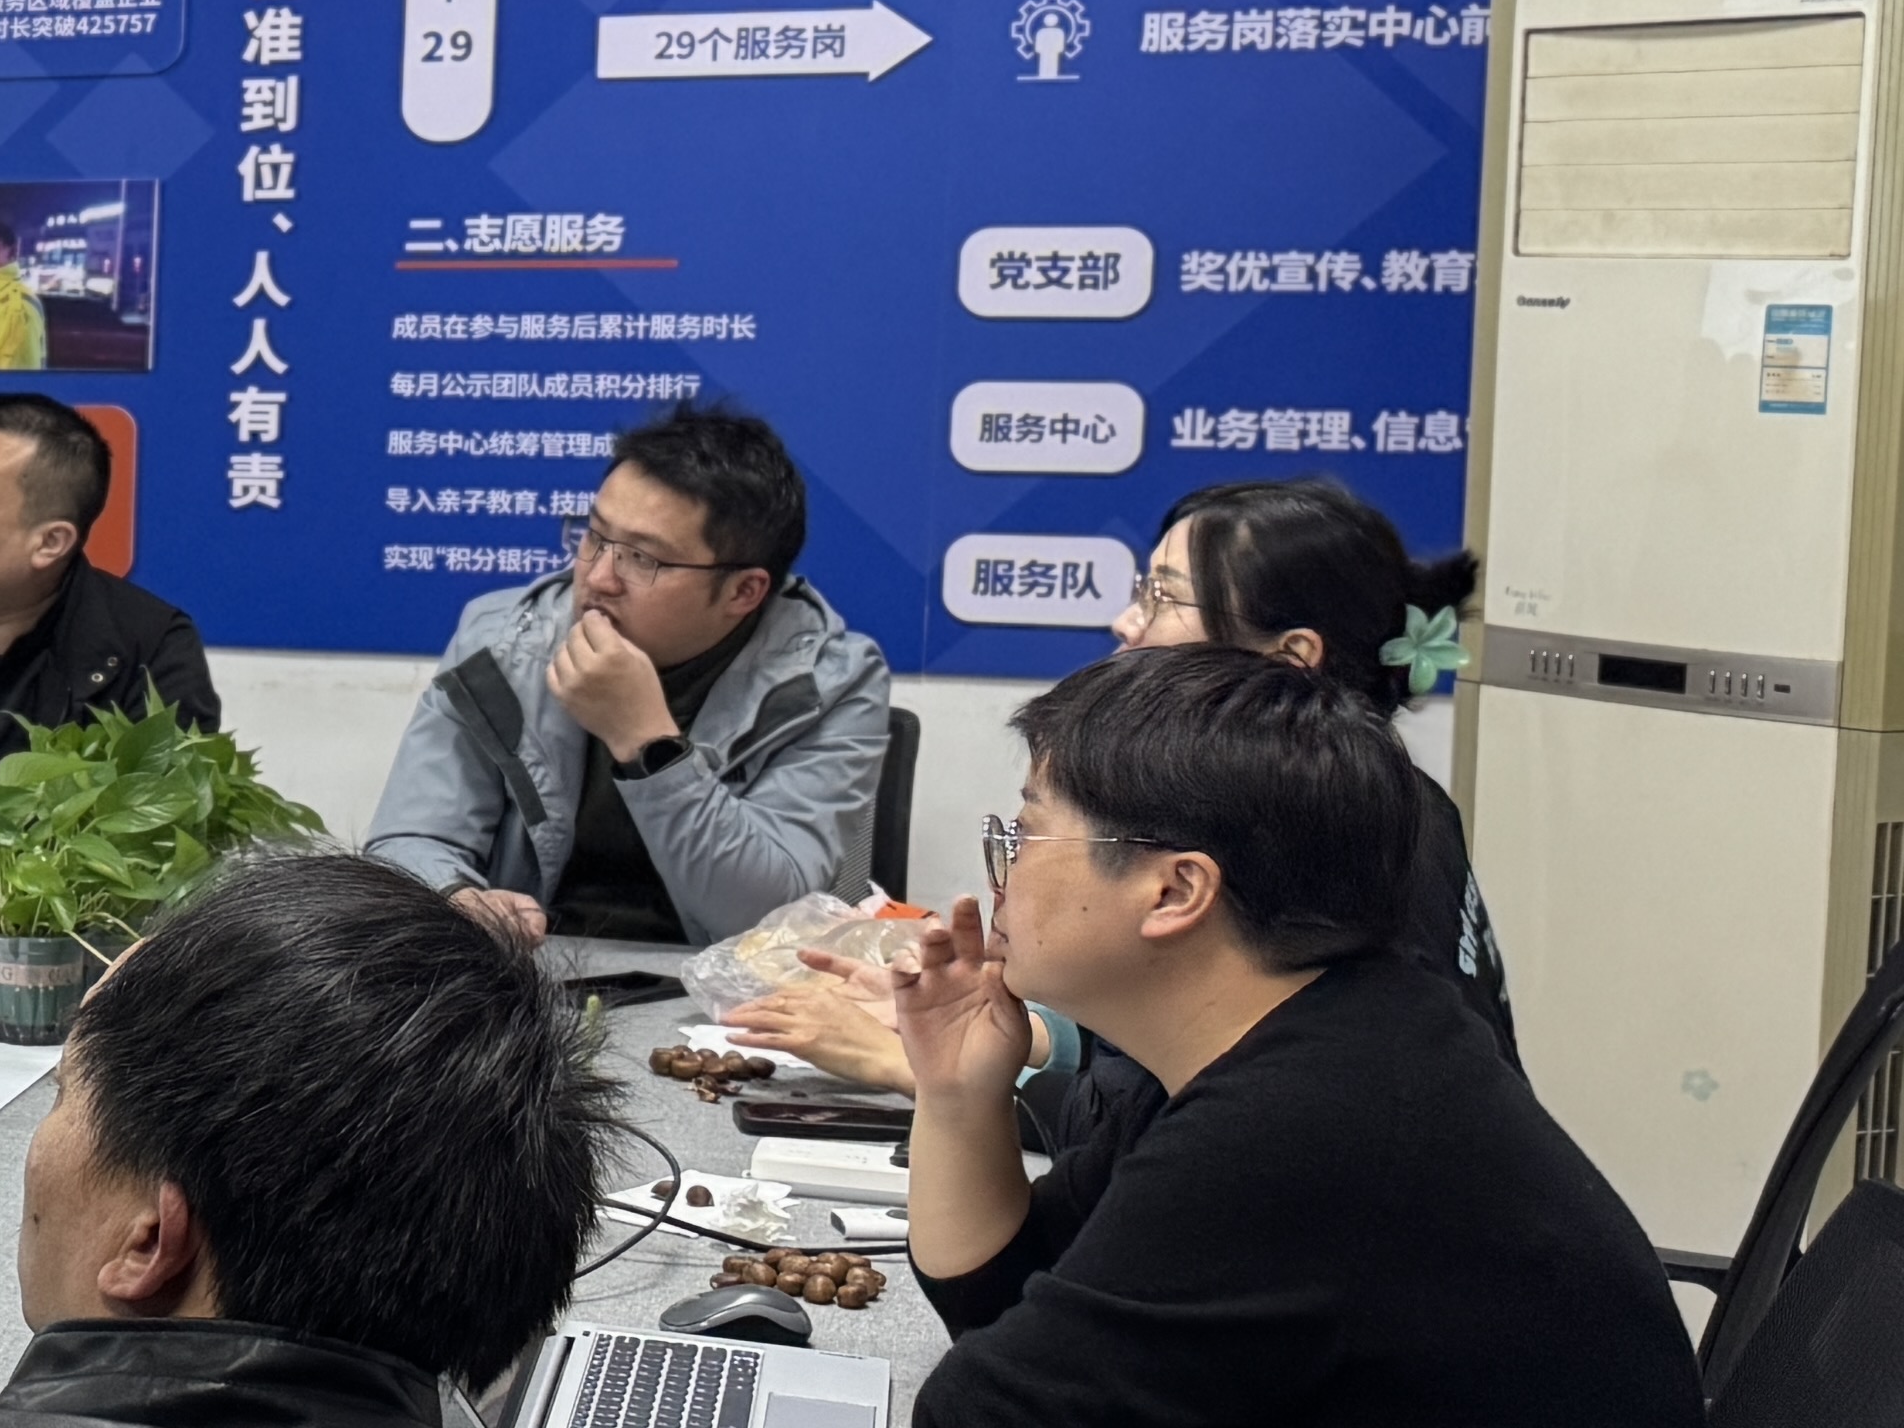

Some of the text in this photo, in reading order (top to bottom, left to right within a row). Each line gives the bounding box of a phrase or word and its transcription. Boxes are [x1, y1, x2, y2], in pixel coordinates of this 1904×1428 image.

[420, 30, 475, 63] 29
[653, 22, 847, 62] 29个服务岗
[404, 212, 626, 254] 二、志愿服务
[988, 251, 1122, 291] 党支部
[1180, 250, 1477, 294] 奖优宣传、教育
[391, 313, 757, 341] 成员在参与服务后累计服务时长
[389, 373, 702, 400] 每月公示团队成员积分排行
[978, 412, 1118, 446] 服务中心
[1170, 407, 1471, 453] 业务管理、信息
[971, 559, 1102, 600] 服务队
